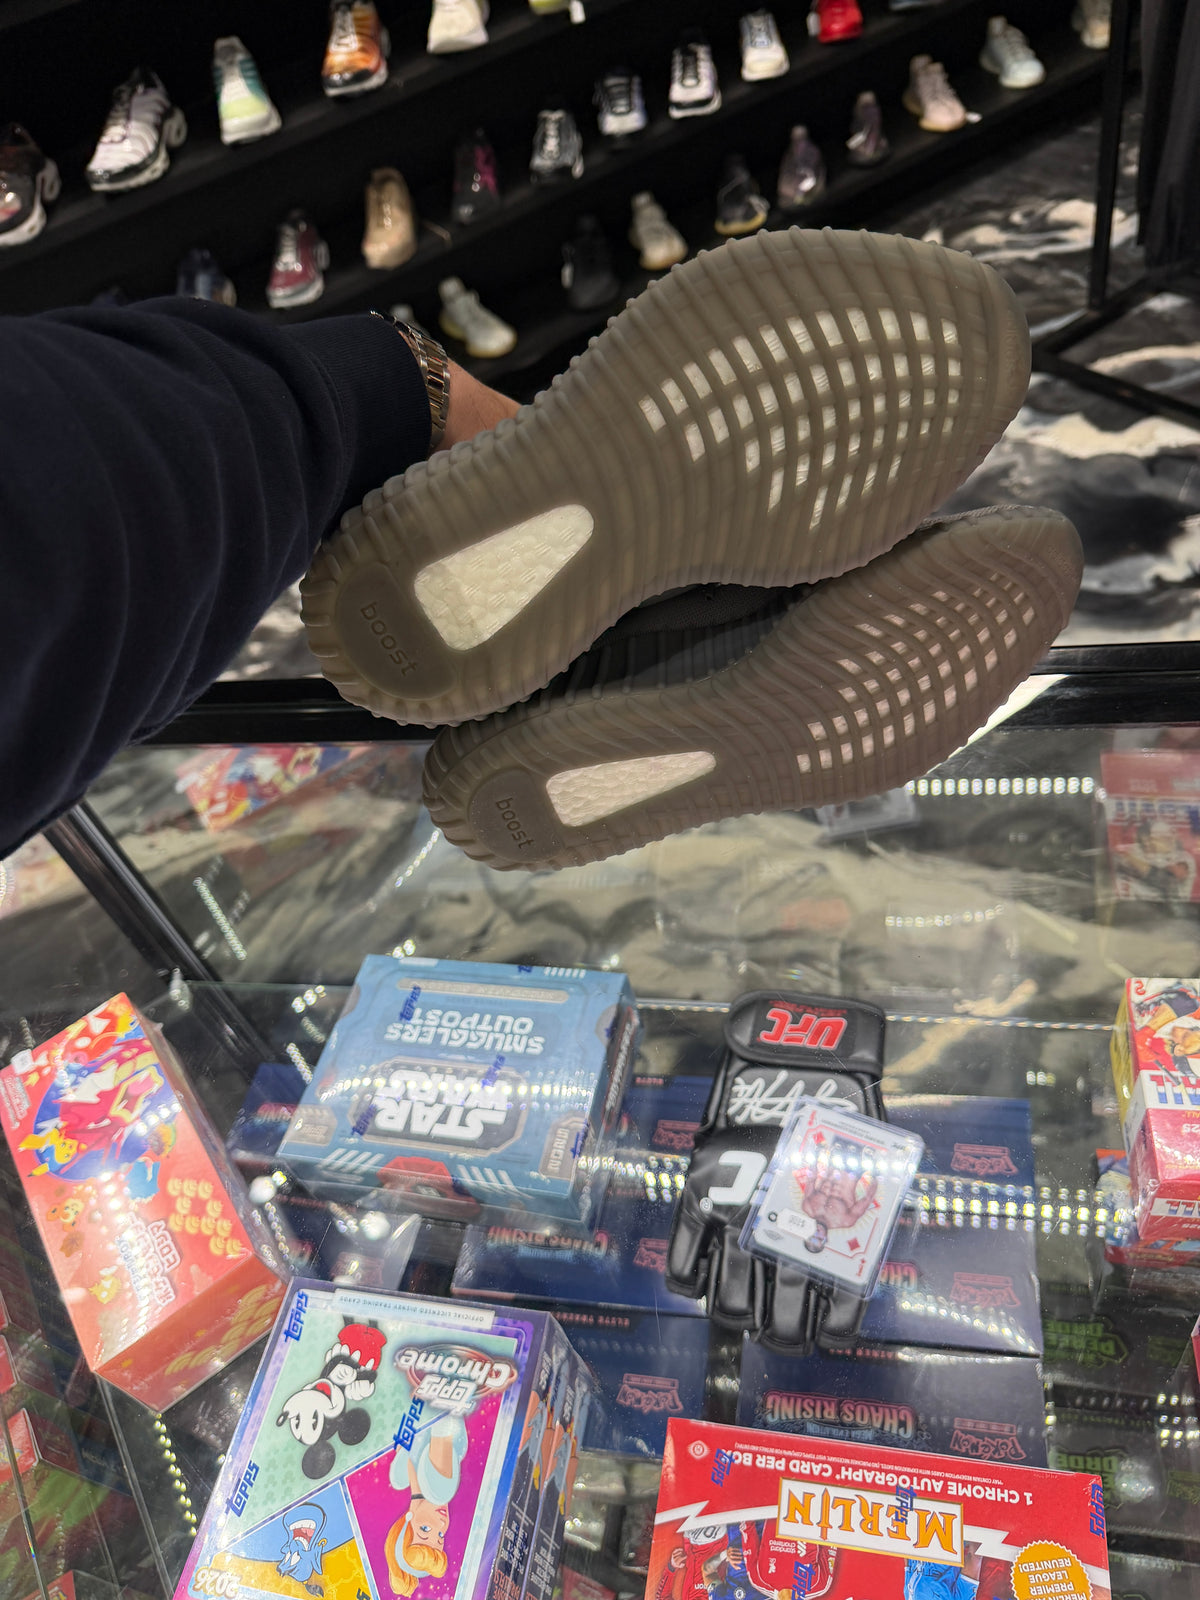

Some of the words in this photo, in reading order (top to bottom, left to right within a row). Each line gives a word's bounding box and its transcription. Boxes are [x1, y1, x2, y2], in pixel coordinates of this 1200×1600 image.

[360, 601, 418, 677] boost
[496, 797, 536, 850] boost
[409, 1008, 534, 1035] OUTPOST
[759, 1008, 847, 1050] UFC
[384, 1022, 545, 1056] SMUGGLERS
[374, 1070, 509, 1110] WARS
[371, 1096, 507, 1141] STAR
[148, 1222, 178, 1270] ヒロシマ
[879, 1262, 918, 1292] CHA
[338, 1296, 361, 1305] CARDS
[362, 1299, 392, 1310] TRADING
[393, 1304, 417, 1314] DISNEY
[418, 1308, 452, 1318] LICENSED
[282, 1290, 309, 1342] topps
[452, 1312, 484, 1323] OFFICIAL
[399, 1349, 510, 1389] Chrome
[416, 1374, 476, 1413] topps
[765, 1393, 836, 1424] RISING
[840, 1400, 913, 1439] CHAOS
[392, 1396, 424, 1452] topps
[711, 1448, 734, 1487] topps
[756, 1454, 786, 1470] PER
[788, 1459, 832, 1477] CARD
[895, 1466, 919, 1474] EXPIRATION
[931, 1470, 944, 1478] CARDS
[224, 1459, 260, 1518] topps
[945, 1472, 972, 1481] REDEMPTION
[972, 1476, 992, 1484] CONTAIN
[947, 1481, 1020, 1504] CHROME
[1024, 1492, 1033, 1506] 1
[783, 1488, 957, 1555] MERLIN
[769, 1540, 796, 1548] chartered
[770, 1545, 796, 1554] standard
[1018, 1558, 1072, 1572] REUNITED!
[1028, 1570, 1068, 1584] LEAGUE
[192, 1566, 240, 1598] 2026
[1029, 1581, 1074, 1596] PREMIER
